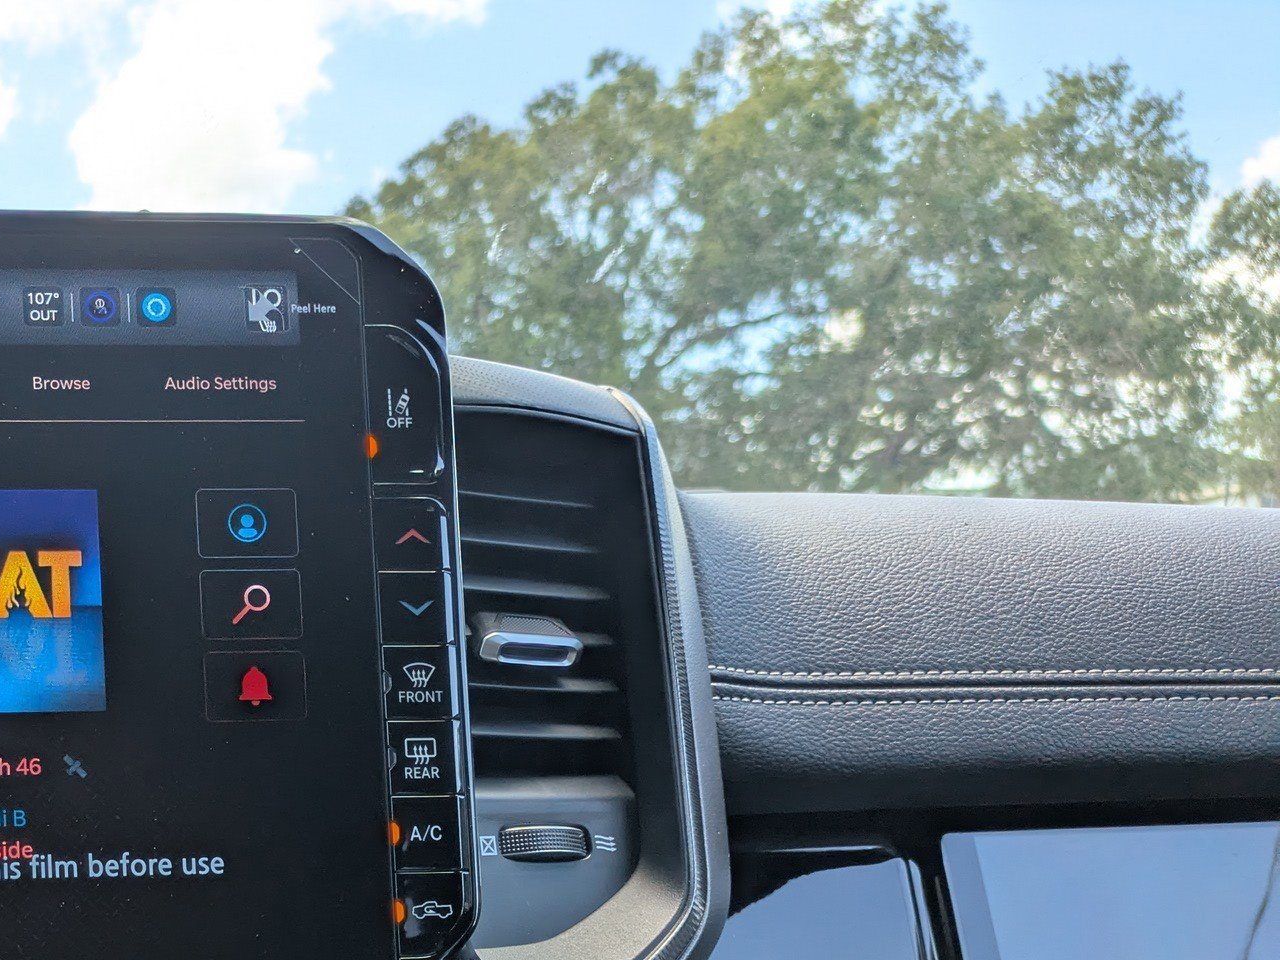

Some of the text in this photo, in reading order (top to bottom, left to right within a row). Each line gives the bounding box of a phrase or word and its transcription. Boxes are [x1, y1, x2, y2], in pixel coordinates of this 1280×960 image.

[27, 291, 60, 305] 107°
[290, 303, 337, 313] Peel Here
[29, 309, 58, 322] OUT
[32, 376, 91, 391] Browse
[164, 376, 278, 394] Audio Settings
[386, 417, 413, 429] OFF
[398, 690, 444, 703] FRONT
[16, 758, 42, 776] 46
[404, 767, 440, 779] REAR
[13, 810, 27, 828] B
[410, 825, 443, 842] A/C
[29, 853, 78, 880] film
[87, 851, 174, 878] before
[183, 855, 225, 876] use
